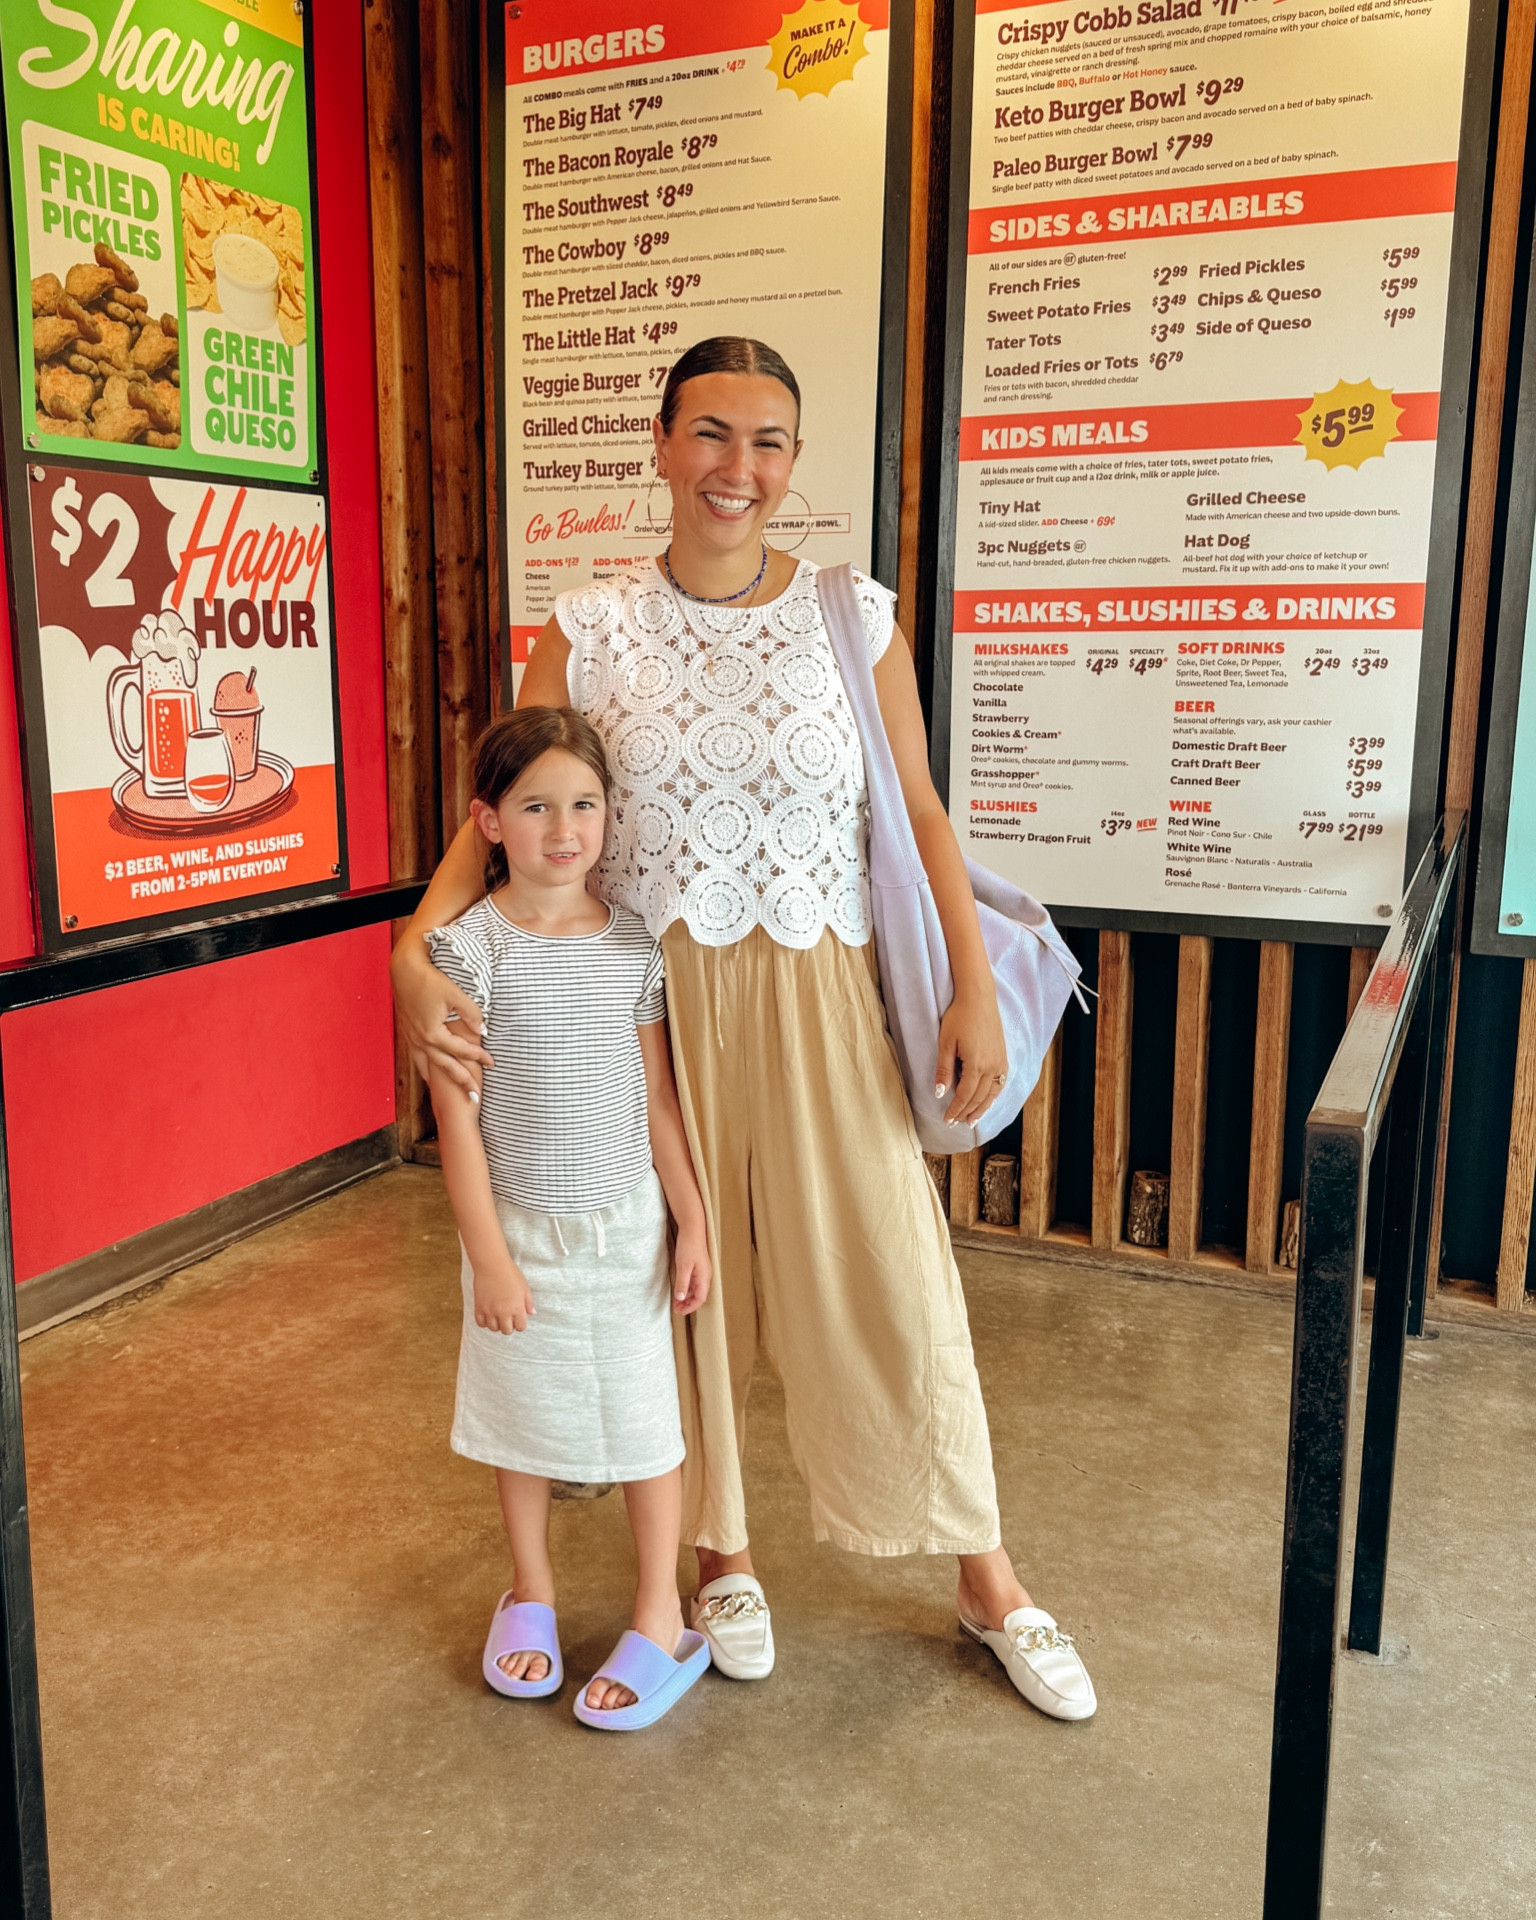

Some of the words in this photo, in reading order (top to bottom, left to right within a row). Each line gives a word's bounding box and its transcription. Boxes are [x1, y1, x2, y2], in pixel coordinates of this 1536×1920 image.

[790, 24, 823, 41] MAKE
[825, 20, 835, 32] IT
[838, 18, 846, 29] A
[998, 20, 1069, 45] Crispy
[1073, 6, 1132, 33] Cobb
[1137, 0, 1202, 24] Salad
[523, 26, 665, 72] BURGERS
[783, 20, 856, 79] Combo!
[533, 91, 563, 102] COMBO
[563, 88, 585, 97] meals
[586, 86, 606, 94] come
[608, 82, 624, 90] with
[626, 78, 648, 88] FRIES
[649, 75, 664, 84] and
[671, 73, 691, 81] 20oz
[692, 67, 719, 78] DRINK
[523, 114, 555, 133] The
[558, 108, 587, 129] Big
[590, 103, 621, 124] Hat
[994, 106, 1044, 128] Keto
[1048, 98, 1125, 122] Burger
[1129, 84, 1186, 112] Bowl
[98, 94, 126, 131] IS
[131, 106, 240, 172] CARING!
[523, 158, 555, 177] The
[558, 154, 611, 173] Bacon
[614, 141, 674, 167] Royale
[993, 158, 1041, 178] Paleo
[1045, 153, 1108, 173] Burger
[1111, 142, 1158, 165] Bowl
[39, 144, 159, 221] FRIED
[992, 185, 1014, 193] Single
[1015, 182, 1032, 191] beef
[1033, 181, 1053, 190] patty
[1055, 178, 1072, 186] with
[1073, 175, 1094, 184] diced
[1095, 173, 1118, 182] sweet
[1119, 170, 1154, 180] potatoes
[1155, 167, 1170, 175] and
[1171, 164, 1205, 174] avocado
[1206, 160, 1233, 170] served
[1253, 156, 1269, 165] bed
[1271, 155, 1280, 164] of
[1281, 154, 1302, 163] baby
[1304, 150, 1339, 161] spinach.
[523, 202, 555, 221] The
[558, 191, 649, 217] Southwest
[990, 214, 1071, 242] SIDES
[1075, 211, 1103, 234] &
[1108, 192, 1304, 230] SHAREABLES
[44, 201, 161, 261] PICKLES
[522, 245, 555, 264] The
[558, 240, 627, 260] Cowboy
[1199, 262, 1241, 278] Fried
[1245, 259, 1305, 274] Pickles
[522, 289, 554, 308] The
[557, 282, 617, 305] Pretzel
[619, 278, 658, 300] Jack
[989, 279, 1040, 295] French
[1043, 276, 1080, 290] Fries
[1197, 292, 1244, 308] Chips
[1247, 289, 1263, 303] &
[1267, 288, 1322, 305] Queso
[987, 308, 1034, 323] Sweet
[1037, 305, 1090, 318] Potato
[1093, 300, 1131, 314] Fries
[522, 332, 554, 351] The
[557, 328, 601, 349] Little
[605, 326, 636, 345] Hat
[1196, 321, 1232, 335] Side
[1236, 318, 1254, 333] of
[1257, 318, 1312, 334] Queso
[204, 327, 294, 377] GREEN
[986, 337, 1026, 350] Tater
[1029, 334, 1061, 347] Tots
[985, 362, 1040, 377] Loaded
[1044, 360, 1081, 373] Fries
[1084, 360, 1102, 371] or
[1104, 356, 1139, 369] Tots
[205, 367, 294, 417] CHILE
[522, 374, 580, 398] Veggie
[583, 373, 642, 393] Burger
[205, 409, 296, 451] QUESO
[523, 417, 578, 437] Grilled
[581, 414, 651, 434] Chicken
[981, 426, 1046, 450] KIDS
[1052, 421, 1148, 446] MEALS
[523, 461, 582, 482] Turkey
[585, 459, 643, 481] Burger
[979, 502, 1010, 516] Tiny
[1014, 500, 1041, 513] Hat
[1186, 493, 1242, 506] Grilled
[1246, 492, 1306, 504] Cheese
[526, 514, 553, 543] Go
[557, 499, 635, 539] Bunless!
[1185, 513, 1207, 521] Made
[1325, 509, 1377, 518] upside-down
[51, 476, 141, 608] $2
[171, 486, 326, 613] Happy
[978, 541, 1004, 556] 3pc
[1007, 540, 1071, 555] Nuggets
[1184, 535, 1214, 548] Hat
[1217, 534, 1250, 549] Dog
[977, 560, 1011, 568] Hand-cut,
[1066, 558, 1107, 566] gluten-free
[1138, 557, 1171, 565] nuggets.
[974, 602, 1091, 625] SHAKES,
[1097, 598, 1237, 623] SLUSHIES
[1242, 598, 1271, 620] &
[1276, 596, 1396, 621] DRINKS
[194, 597, 318, 649] HOUR
[974, 643, 1069, 655] MILKSHAKES
[1178, 642, 1219, 654] SOFT
[1222, 642, 1285, 654] DRINKS
[973, 683, 1024, 692] Chocolate
[973, 698, 1007, 707] Vanilla
[1174, 701, 1215, 713] BEER
[972, 714, 1029, 724] Strawberry
[1172, 741, 1225, 751] Domestic
[1227, 742, 1258, 751] Draft
[1260, 742, 1287, 752] Beer
[970, 800, 1038, 813] SLUSHIES
[1169, 800, 1212, 813] WINE
[970, 816, 1021, 825] Lemonade
[1168, 817, 1189, 826] Red
[1192, 818, 1220, 827] Wine
[105, 861, 124, 881] $2
[126, 856, 169, 876] BEER,
[170, 848, 214, 867] WINE,
[215, 843, 244, 861] AND
[245, 833, 304, 857] SLUSHIES
[1167, 843, 1200, 852] White
[1203, 844, 1231, 853] Wine
[131, 877, 175, 898] FROM
[177, 869, 221, 890] 2-5PM
[223, 857, 288, 881] EVERYDAY
